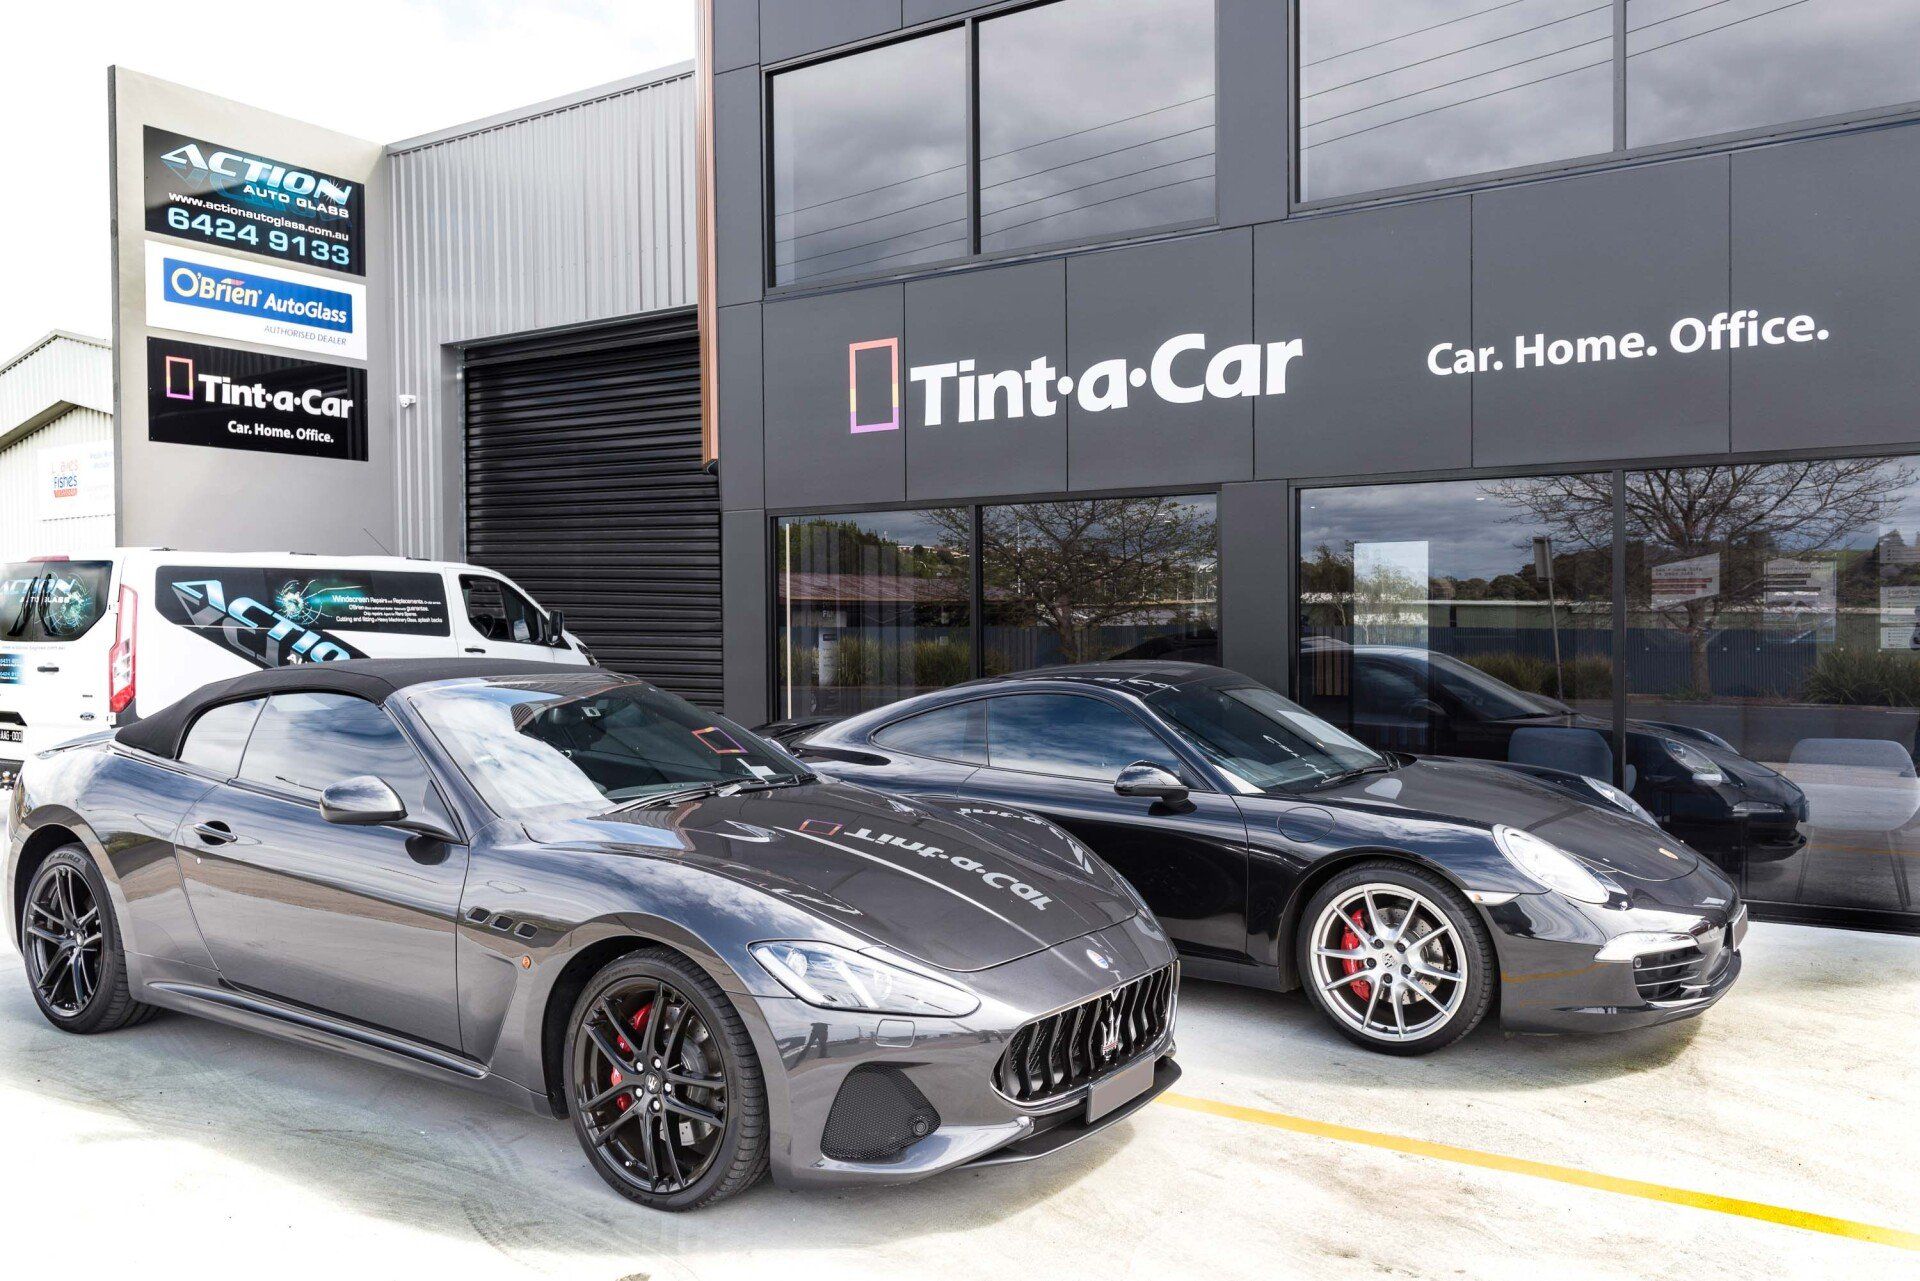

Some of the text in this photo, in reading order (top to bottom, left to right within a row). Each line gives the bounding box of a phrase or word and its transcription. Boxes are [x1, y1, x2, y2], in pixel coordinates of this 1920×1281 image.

[161, 144, 352, 205] ACTION
[168, 192, 349, 241] www.actionautoglass.com.au
[243, 185, 349, 218] AUTO GLASS
[168, 207, 350, 265] 6424 9133
[263, 293, 347, 323] AutoGlass
[264, 325, 347, 346] AUTHORISED DEALER
[1427, 309, 1830, 376] Car. Home. Office.
[227, 420, 335, 443] Car. Home. Office.
